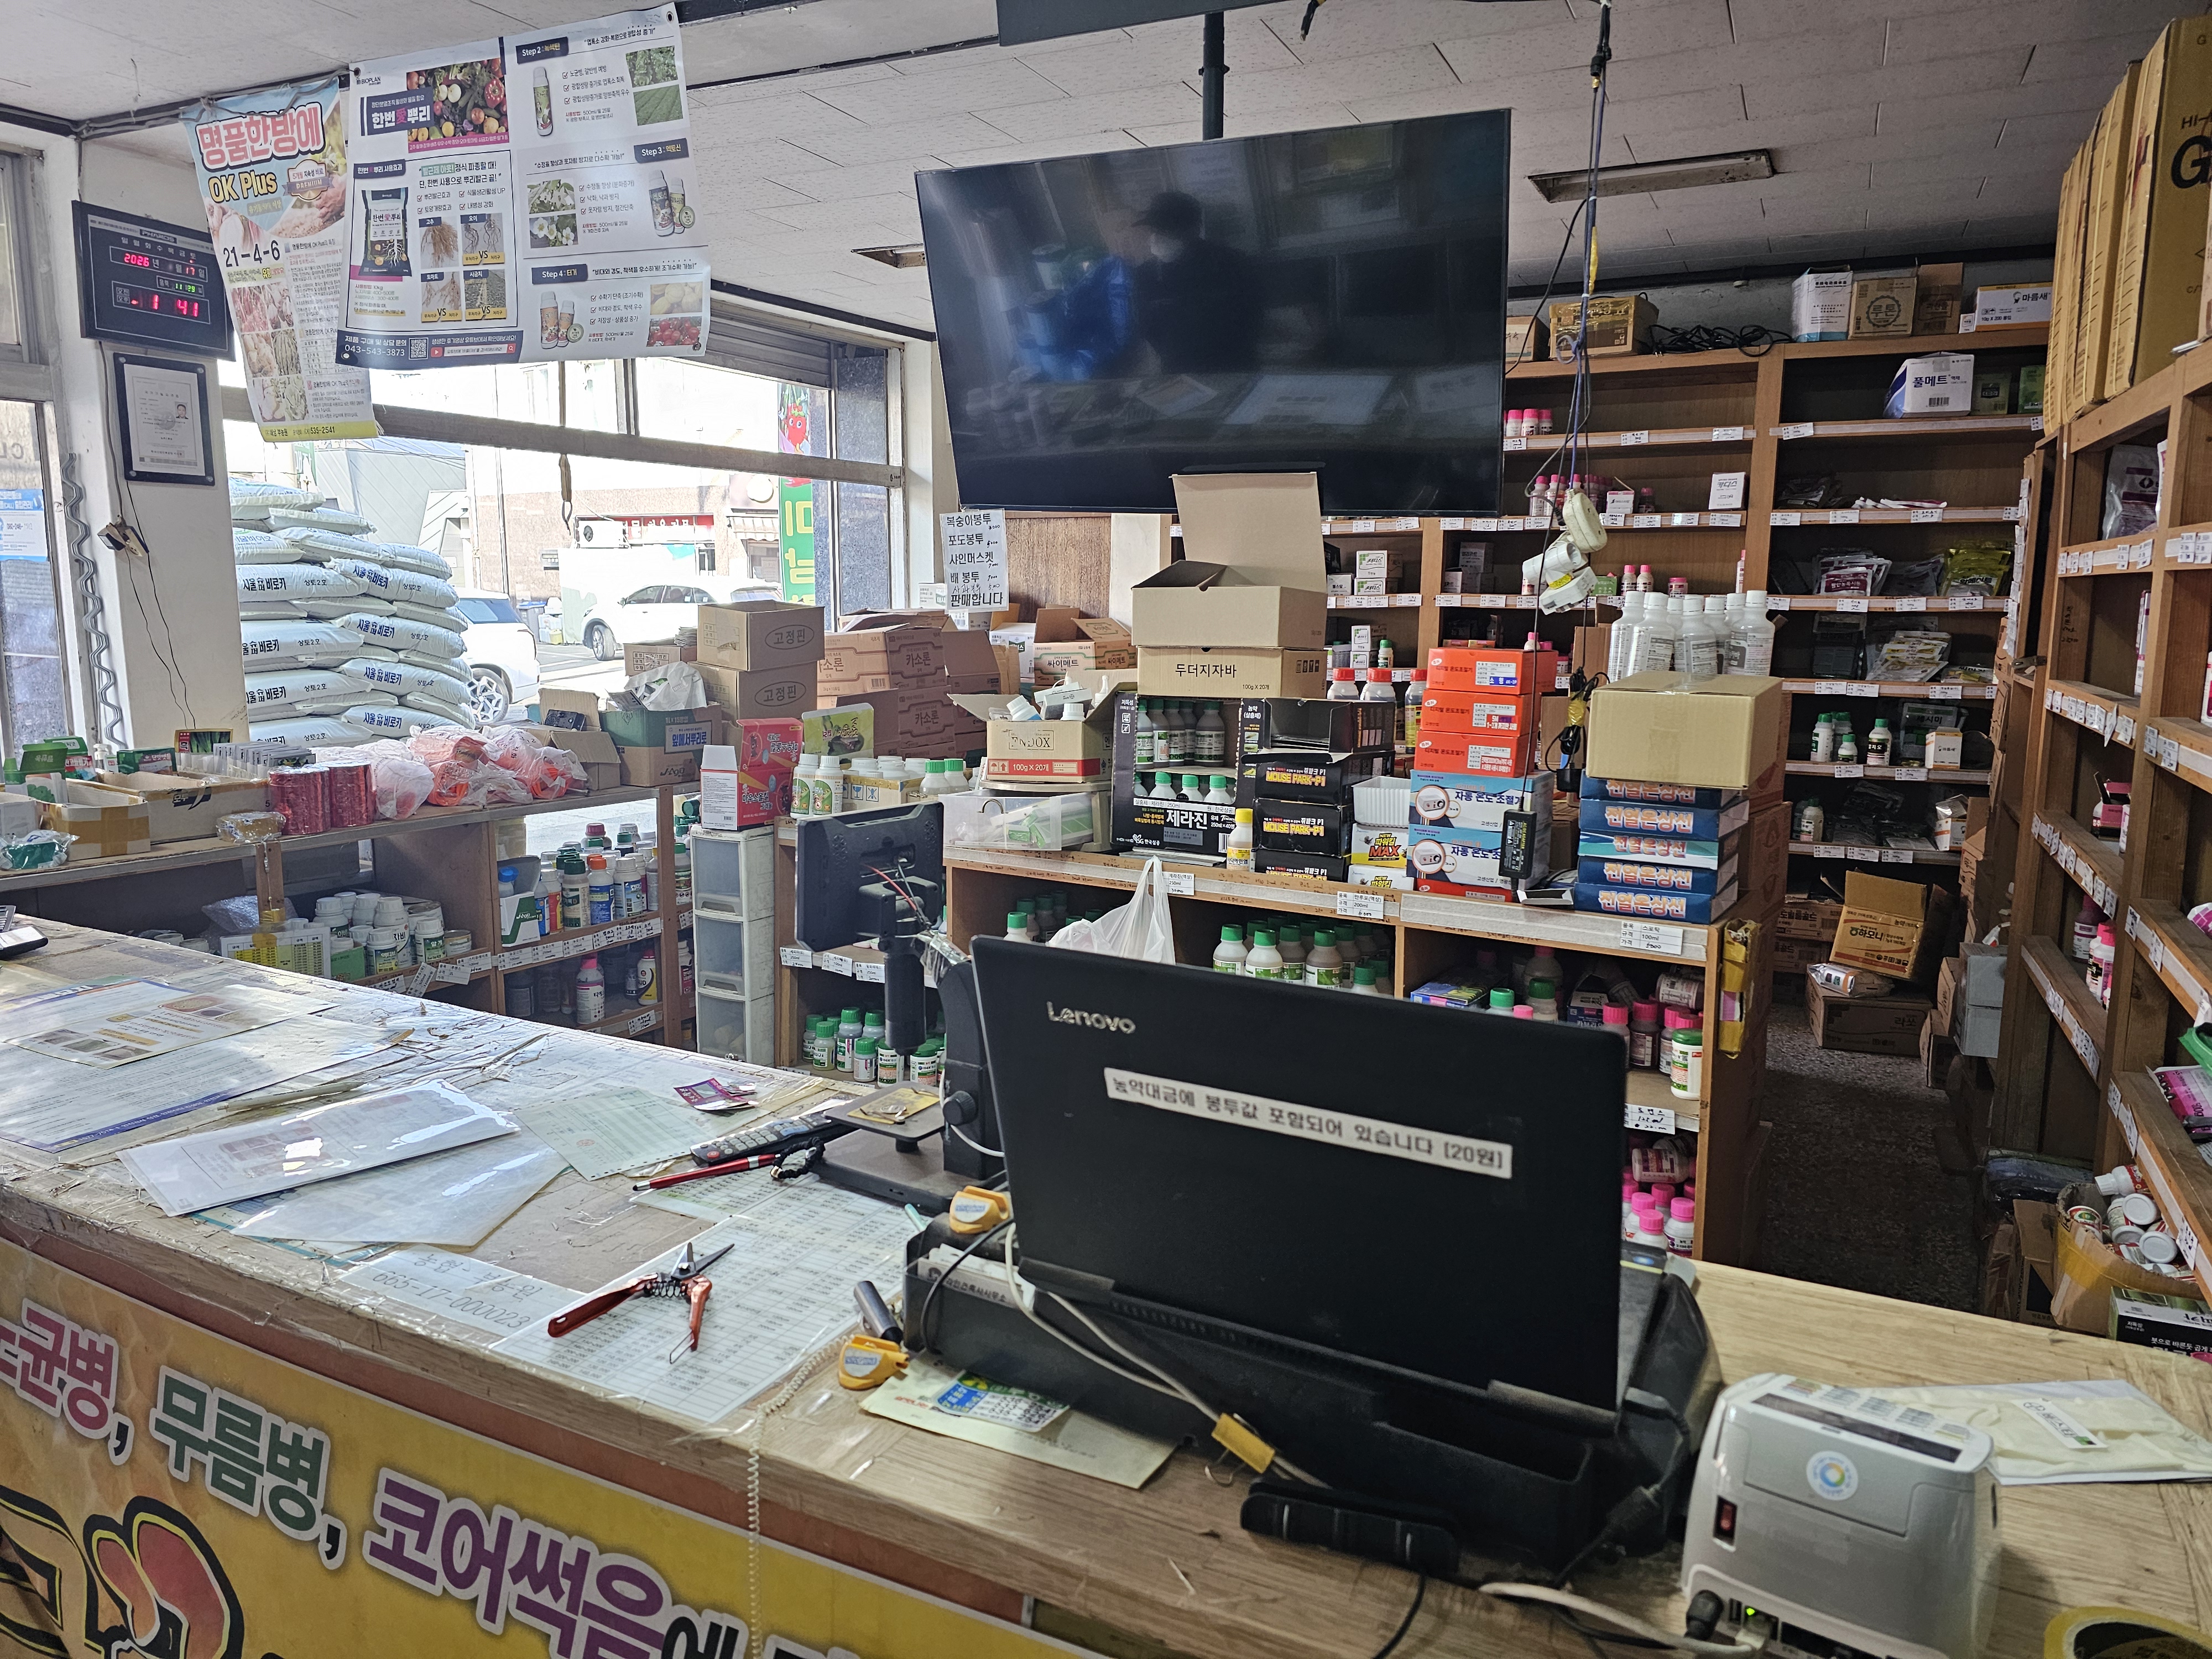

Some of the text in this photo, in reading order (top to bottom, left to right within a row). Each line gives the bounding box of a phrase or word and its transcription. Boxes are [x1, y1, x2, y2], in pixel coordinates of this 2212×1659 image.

[523, 48, 536, 57] Step
[362, 76, 380, 85] BIOPLAN
[197, 105, 323, 168] 명품한방에
[641, 148, 657, 157] Step
[455, 161, 497, 172] 정식 파종할 때!
[208, 170, 277, 202] OK Plus
[427, 174, 488, 187] 한번 사용으로 뿌리발근
[223, 241, 280, 268] 21-4-6
[478, 251, 488, 259] VS
[124, 253, 205, 278] 2026 년 월 17 일
[542, 270, 558, 279] Step
[2022, 291, 2048, 302] 마름새
[178, 299, 199, 317] 41
[437, 308, 446, 316] VS
[481, 306, 491, 314] VS
[1870, 303, 1898, 318] 루톤
[361, 337, 374, 345] 구매
[345, 345, 405, 356] 043-543-3873
[1912, 375, 1949, 388] 풀메트
[310, 426, 335, 435] 535-2541
[947, 513, 991, 527] 복숭아봉투
[948, 533, 983, 546] 포도봉투
[950, 551, 994, 565] 샤인머스켓
[951, 572, 979, 583] 배 봉투
[951, 592, 1003, 607] 판매합니다
[774, 629, 806, 644] 고정핀
[906, 652, 931, 667] 카소론
[1047, 659, 1079, 667] 싸이메트
[1108, 656, 1126, 665] 싸이메트
[1175, 664, 1237, 679] 두더지자바
[304, 683, 327, 692] 상토2호
[763, 685, 797, 702] 고정핀
[915, 711, 939, 726] 카소론
[304, 733, 327, 741] 상토2호
[672, 732, 707, 747] 잎에서뿌리로
[1266, 771, 1326, 786] MOUSE PARK-P1
[742, 791, 769, 804] 마우스올킬
[1455, 791, 1472, 802] 자동
[1475, 792, 1493, 803] 온도
[1606, 780, 1696, 804] 전열온상선
[1166, 810, 1208, 830] 제라진
[1605, 806, 1694, 834] 전열온상선
[1263, 821, 1324, 836] MOUSE PARK-P1
[1368, 845, 1402, 857] MAX
[1451, 846, 1489, 858] 자동 온도
[1613, 836, 1687, 858] 전열온상선
[1604, 862, 1692, 890] 전열온상선
[1598, 890, 1687, 919] 전열온상선
[1858, 927, 1884, 941] 하모니
[1046, 1000, 1136, 1035] Lenovo
[1112, 1076, 1196, 1109] 농약대금에
[1204, 1094, 1259, 1121] 봉투값
[1267, 1108, 1343, 1137] 포함되어
[1353, 1123, 1433, 1156] 있습니다
[373, 1270, 531, 1328] 665-17-000023
[2151, 1337, 2171, 1347] 붓으로
[2172, 1340, 2193, 1350] 바른듯
[154, 1375, 342, 1561] 무름병,
